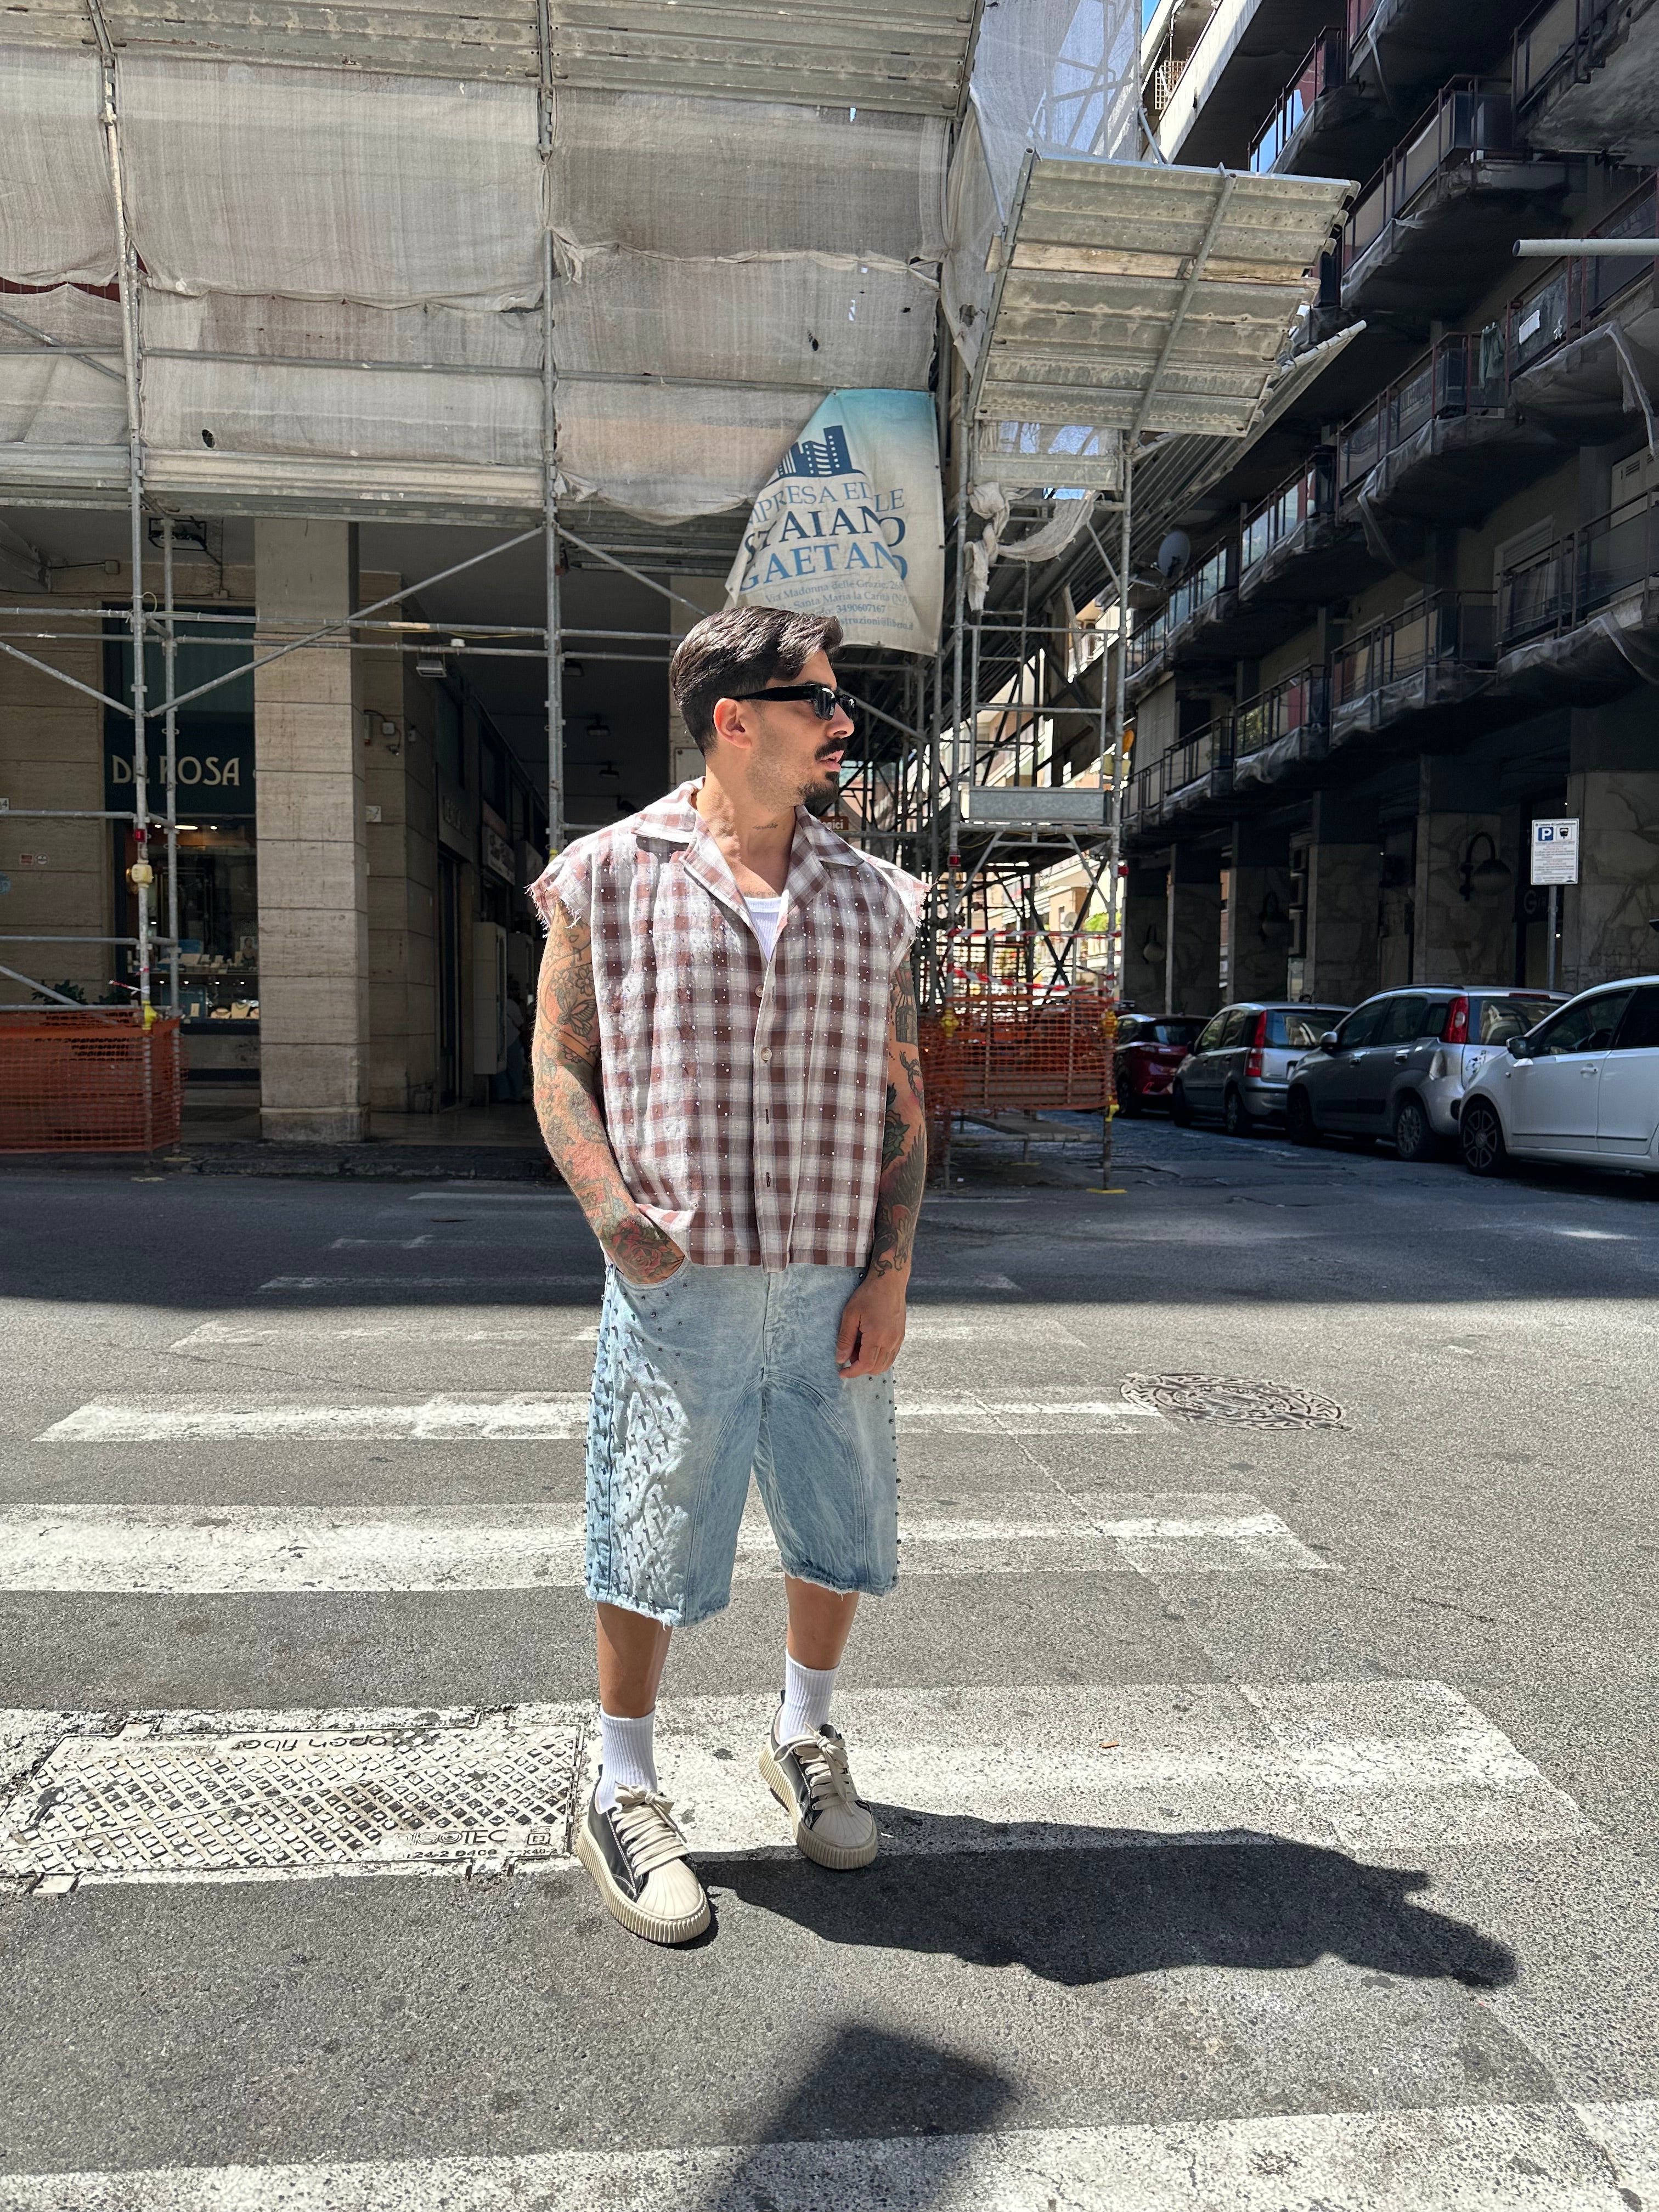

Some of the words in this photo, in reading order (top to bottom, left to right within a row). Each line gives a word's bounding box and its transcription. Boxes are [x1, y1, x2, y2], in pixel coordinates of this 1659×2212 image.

[765, 594, 781, 602] Via
[783, 584, 829, 597] Madonna
[832, 580, 855, 589] delle
[793, 599, 820, 610] Santa
[823, 593, 851, 603] Maria
[853, 591, 862, 600] la
[836, 603, 887, 613] 3490607167
[840, 616, 913, 630] struzioni@libero.it
[1541, 828, 1552, 840] P
[230, 1739, 298, 1752] fiber
[309, 1734, 387, 1747] open
